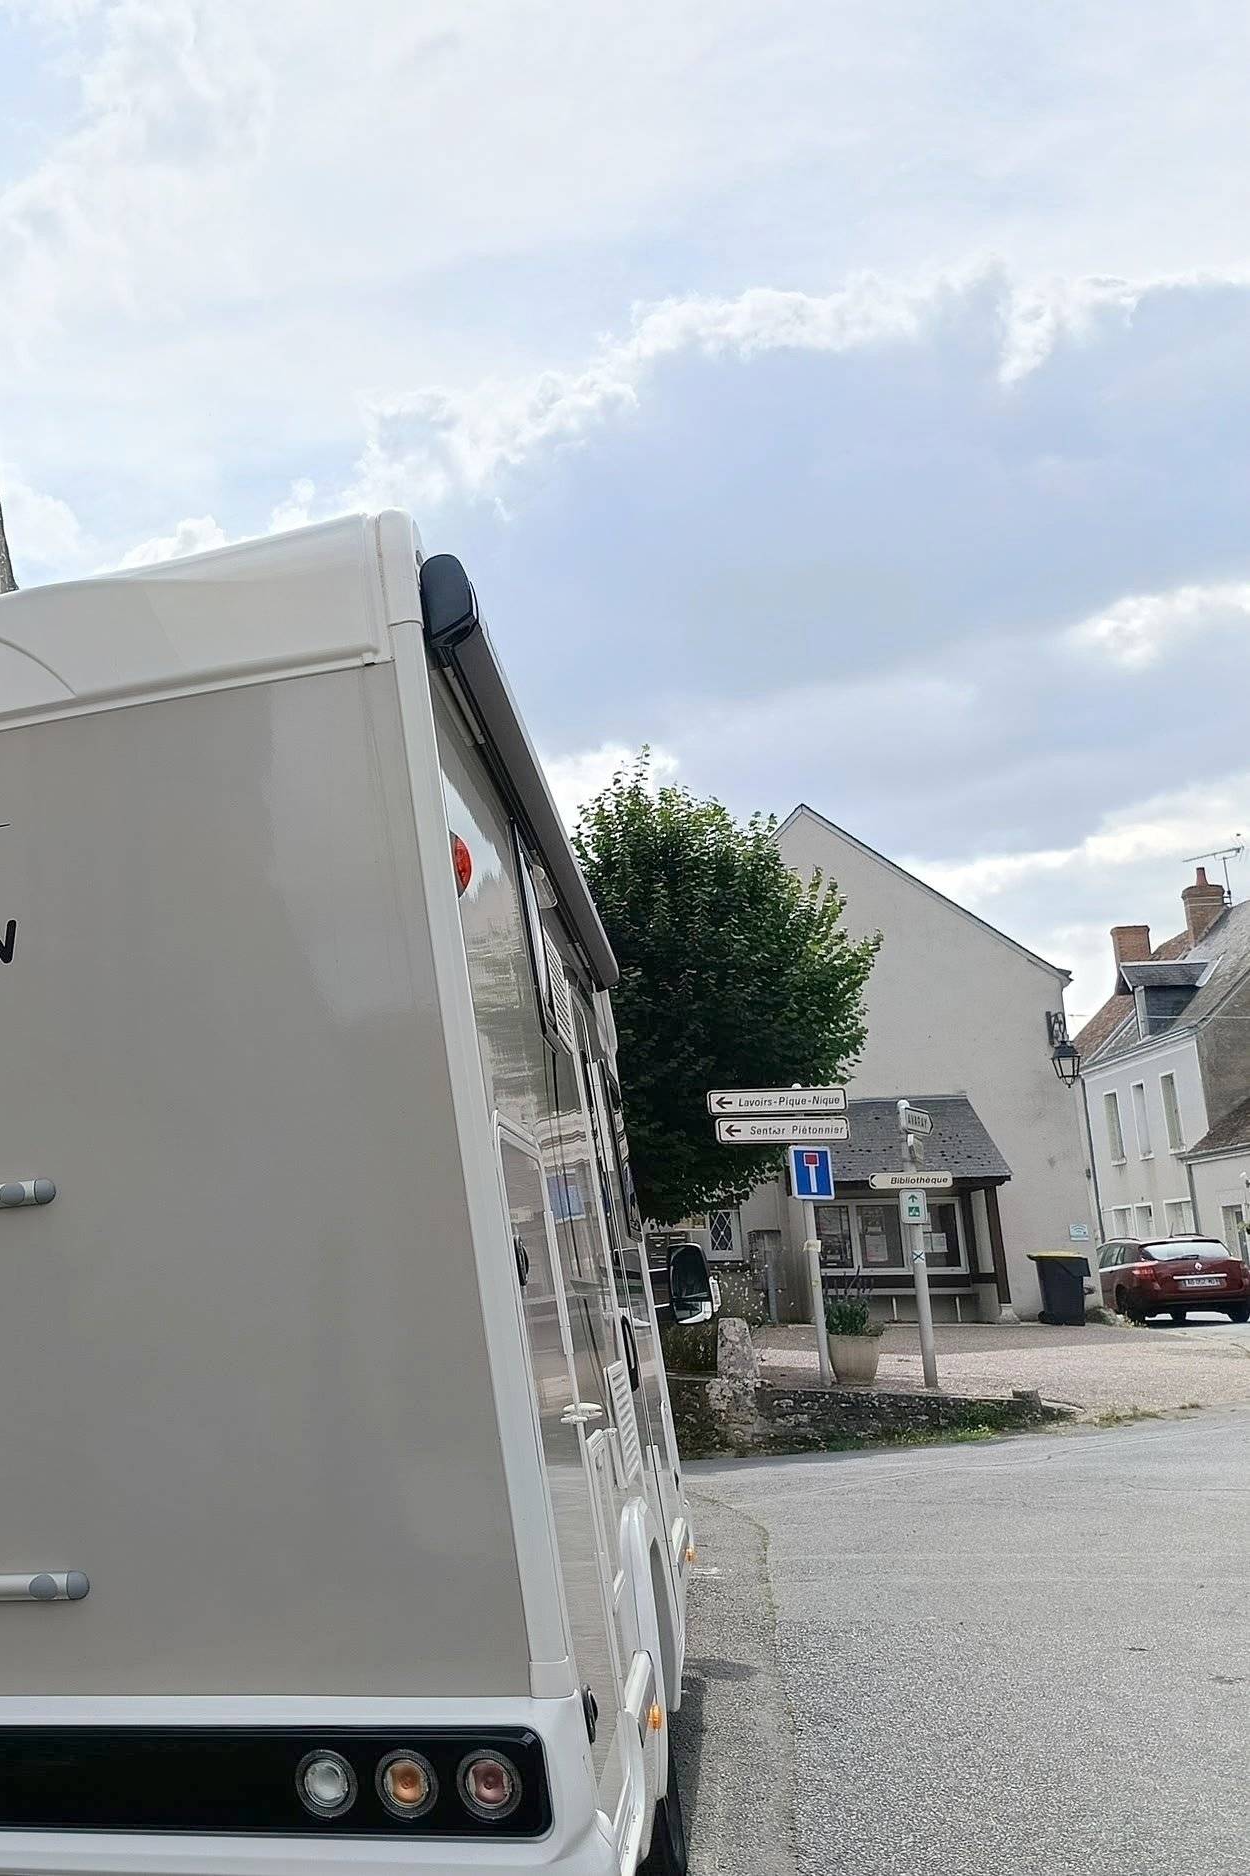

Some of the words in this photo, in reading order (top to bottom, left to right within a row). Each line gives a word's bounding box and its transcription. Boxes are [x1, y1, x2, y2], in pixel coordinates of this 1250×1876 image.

[738, 1096, 840, 1108] Lavoirs-Pique-Nique
[791, 1125, 844, 1135] Piétonnier
[890, 1175, 948, 1186] Bibliothèque
